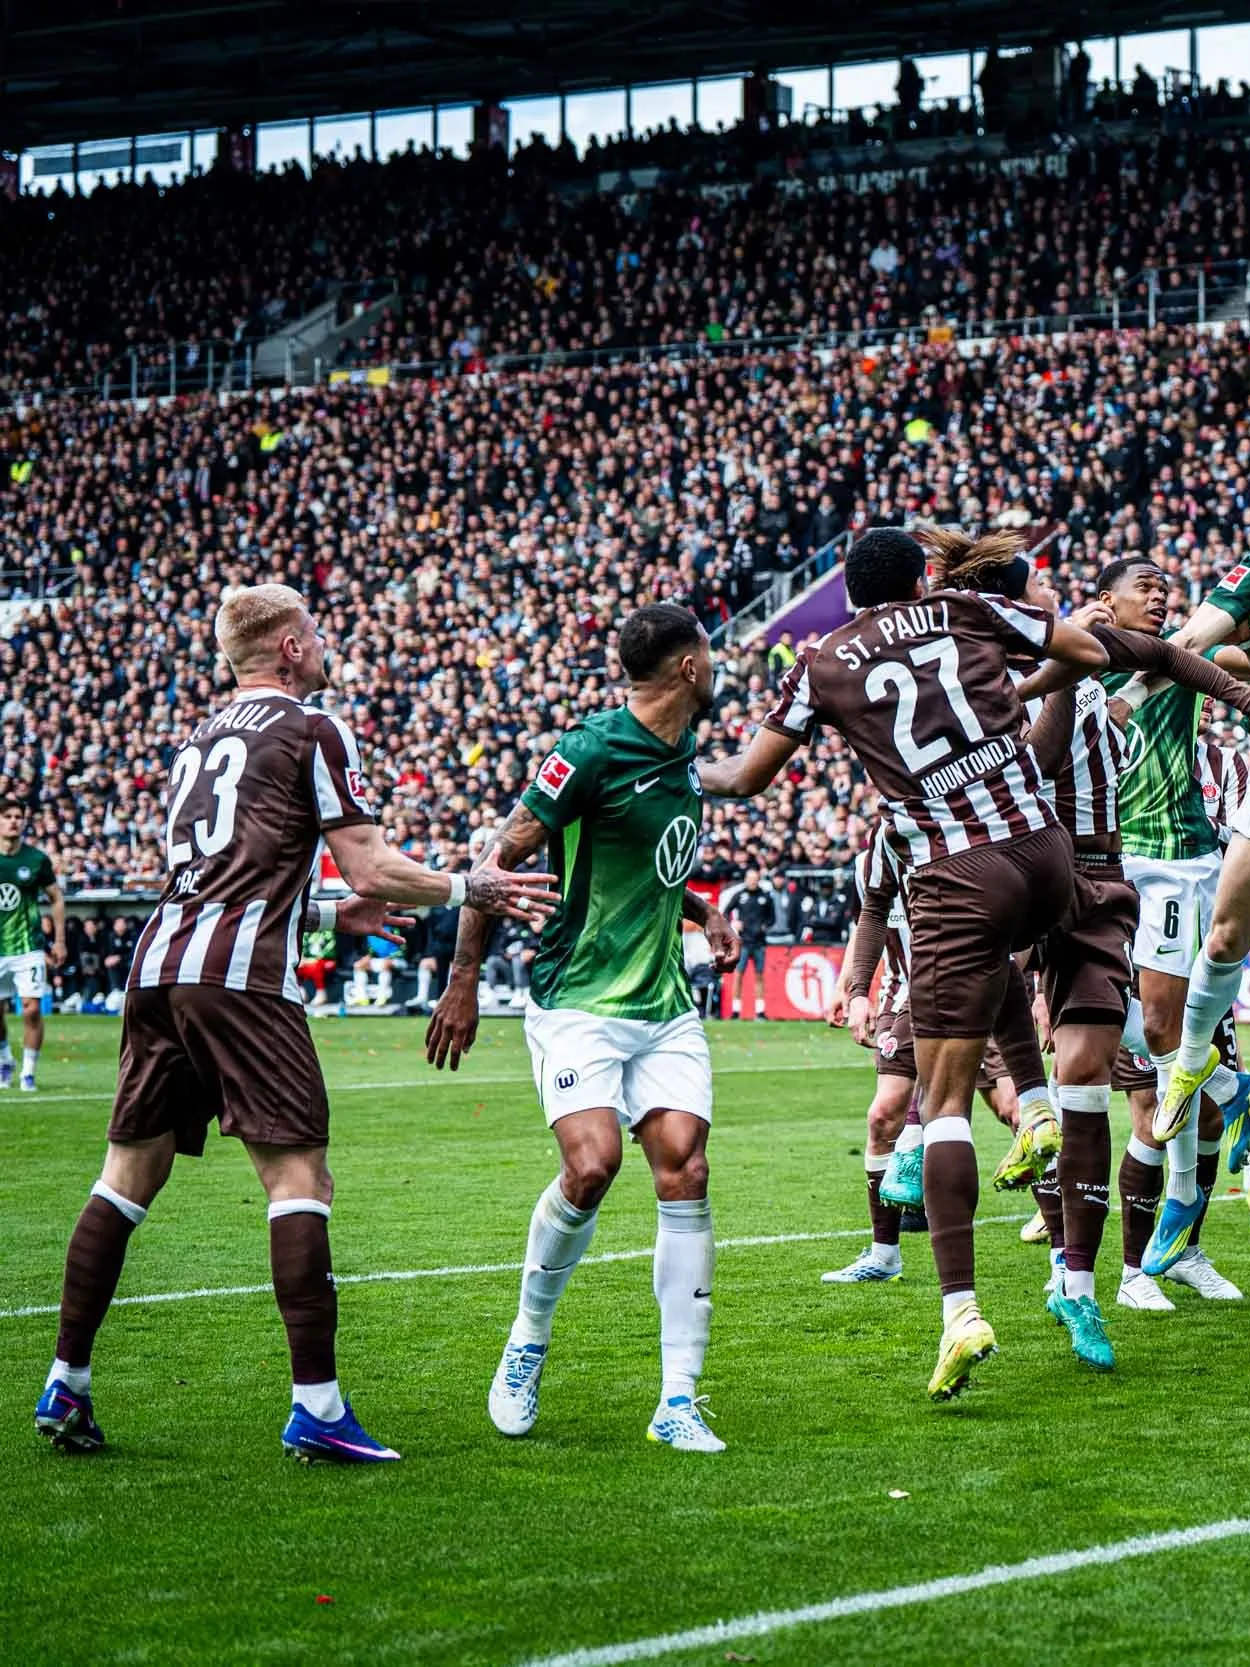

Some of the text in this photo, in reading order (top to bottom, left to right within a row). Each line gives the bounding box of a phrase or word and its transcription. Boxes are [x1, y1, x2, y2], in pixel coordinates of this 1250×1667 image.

[878, 601, 950, 645] PAULI
[865, 636, 985, 774] 27
[1075, 688, 1100, 717] gstar
[920, 734, 1017, 798] HOUNTONDJI
[167, 737, 248, 872] 23
[1164, 900, 1179, 939] 6
[1222, 1017, 1237, 1056] 5
